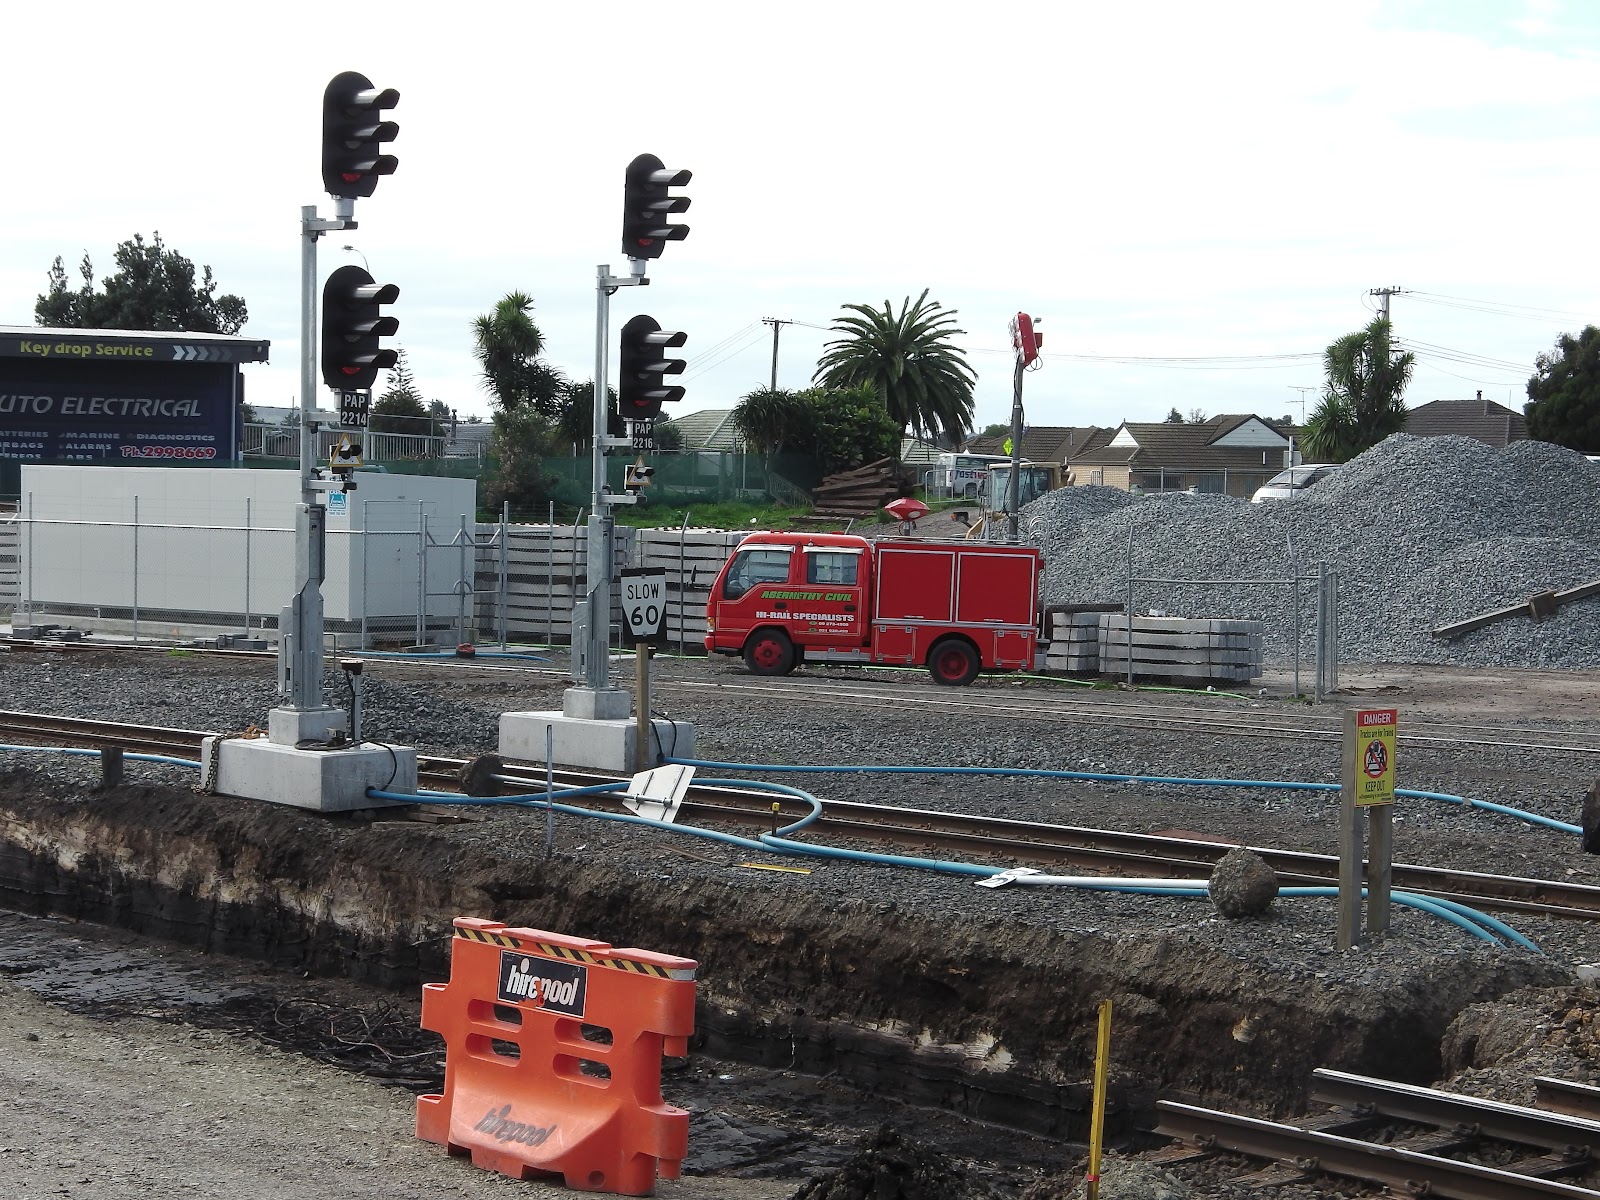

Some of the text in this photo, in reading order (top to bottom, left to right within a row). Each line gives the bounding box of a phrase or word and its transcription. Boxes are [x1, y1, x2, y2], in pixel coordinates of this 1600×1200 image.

[20, 340, 154, 358] Key drop Service
[60, 396, 202, 417] ELECTRICAL
[344, 394, 366, 408] PAP
[341, 411, 367, 426] 2214
[635, 423, 651, 434] PAP
[65, 432, 120, 440] MARINE
[136, 433, 216, 441] DIAGNOSTICS
[633, 437, 653, 449] 2216
[627, 583, 660, 600] SLOW
[761, 591, 852, 601] ABERNETHY CIVIL
[630, 604, 659, 626] 60
[793, 613, 854, 621] SPECIALISTS
[1364, 714, 1391, 724] DANGER
[1365, 780, 1385, 792] KEEP OUT
[473, 1104, 557, 1147] hirepool
